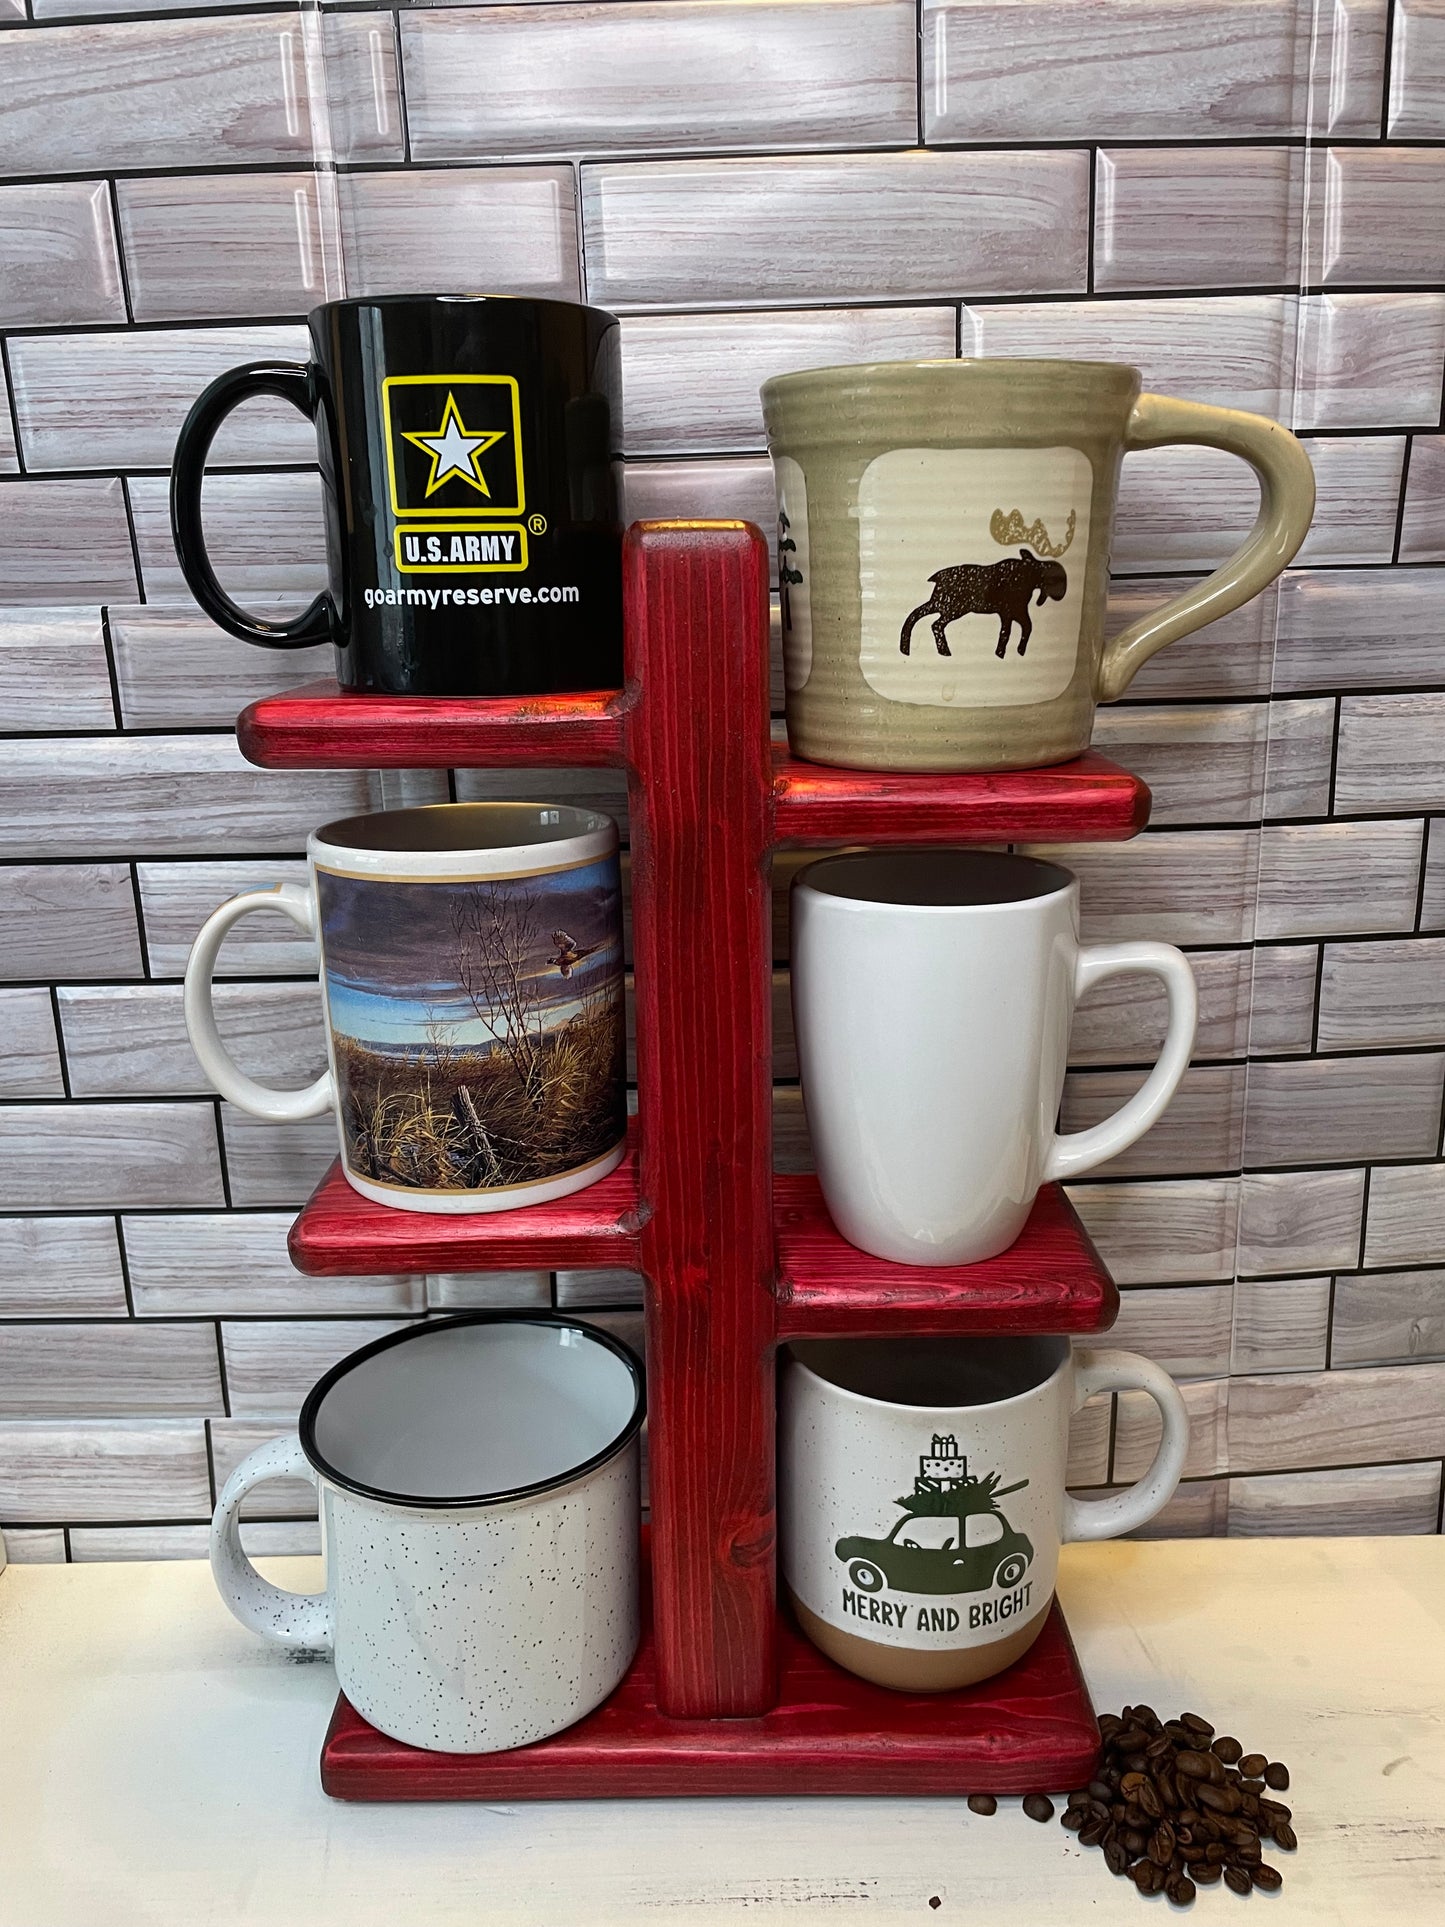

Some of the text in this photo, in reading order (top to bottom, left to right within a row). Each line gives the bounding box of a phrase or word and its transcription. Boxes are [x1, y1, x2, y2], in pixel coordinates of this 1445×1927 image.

[364, 586, 579, 610] goarmyreserve.com
[842, 1581, 1033, 1632] MERRY AND BRIGHT
